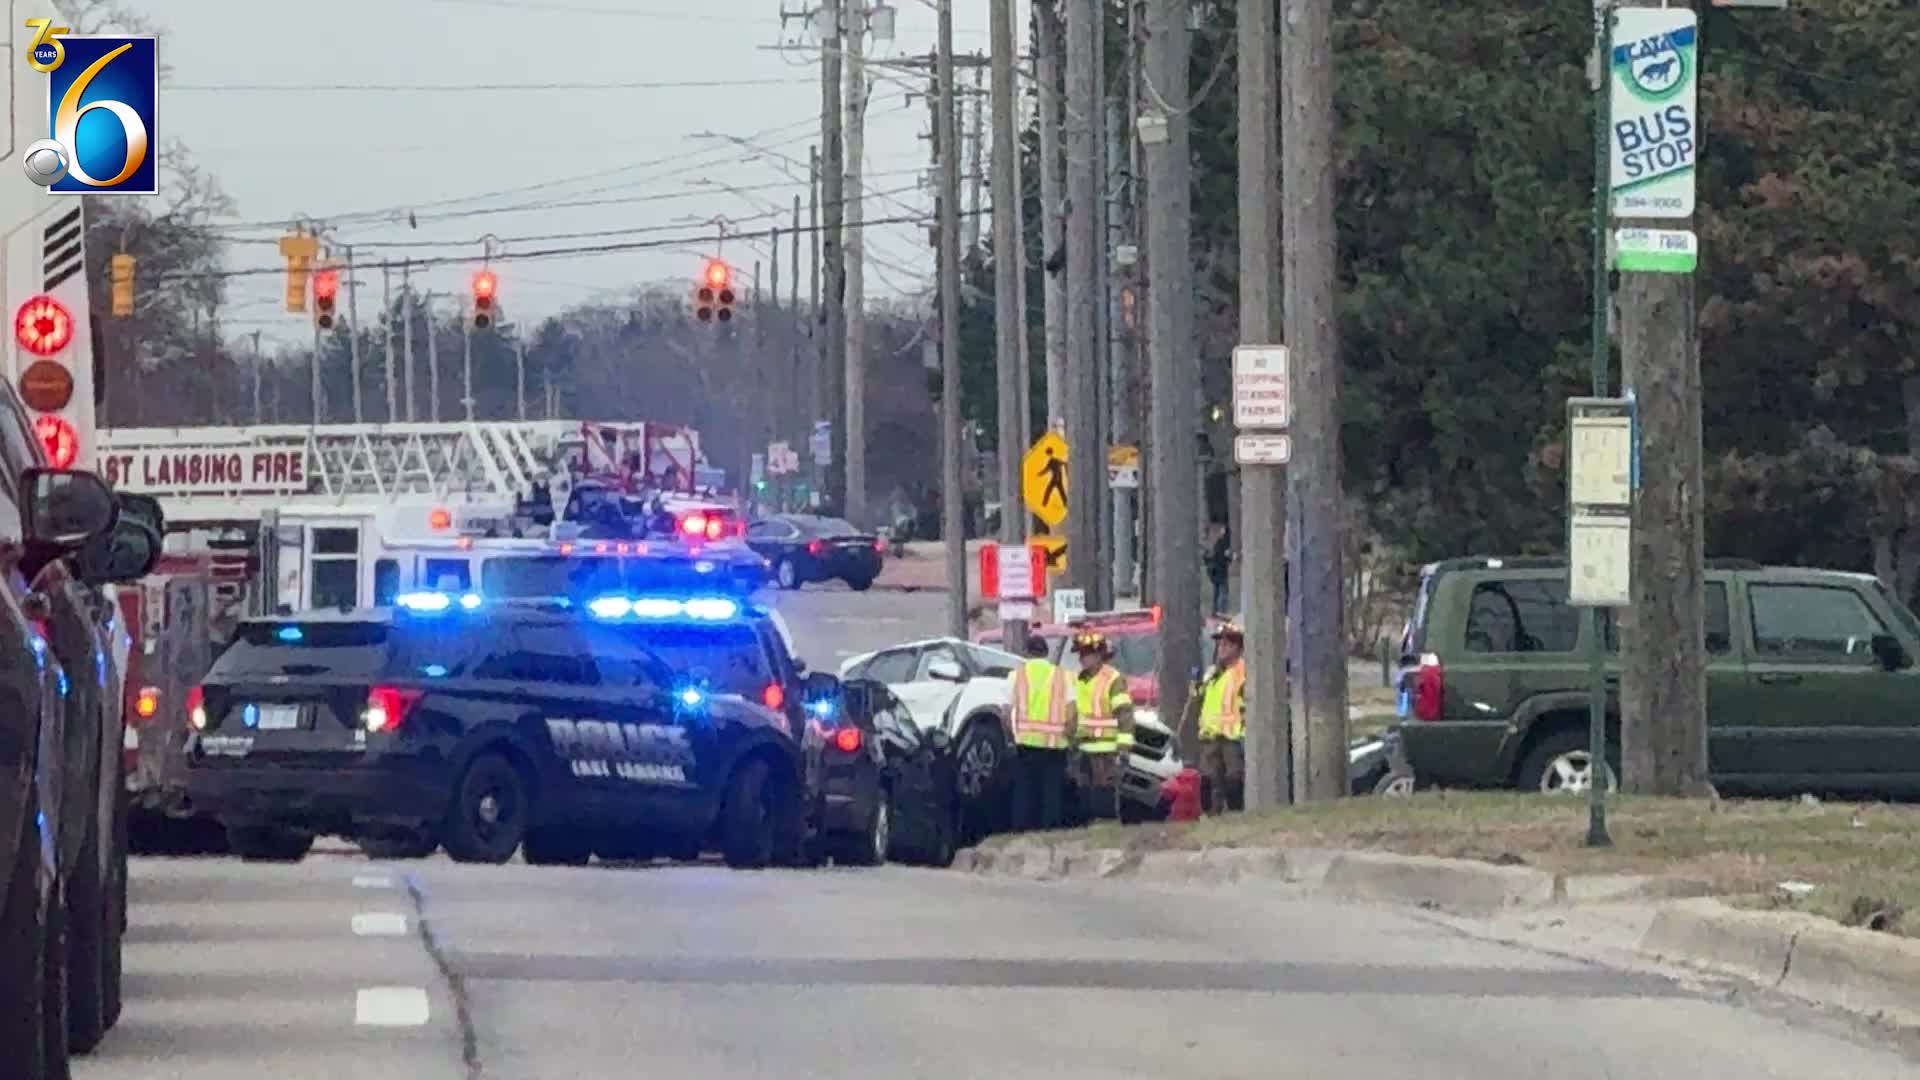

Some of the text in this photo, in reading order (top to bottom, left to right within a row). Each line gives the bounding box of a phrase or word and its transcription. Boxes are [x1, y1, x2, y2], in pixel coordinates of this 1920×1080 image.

[1615, 105, 1691, 152] BUS
[1622, 138, 1693, 178] STOP
[143, 453, 242, 486] LANSING
[252, 452, 304, 484] FIRE
[545, 718, 698, 760] POLICE
